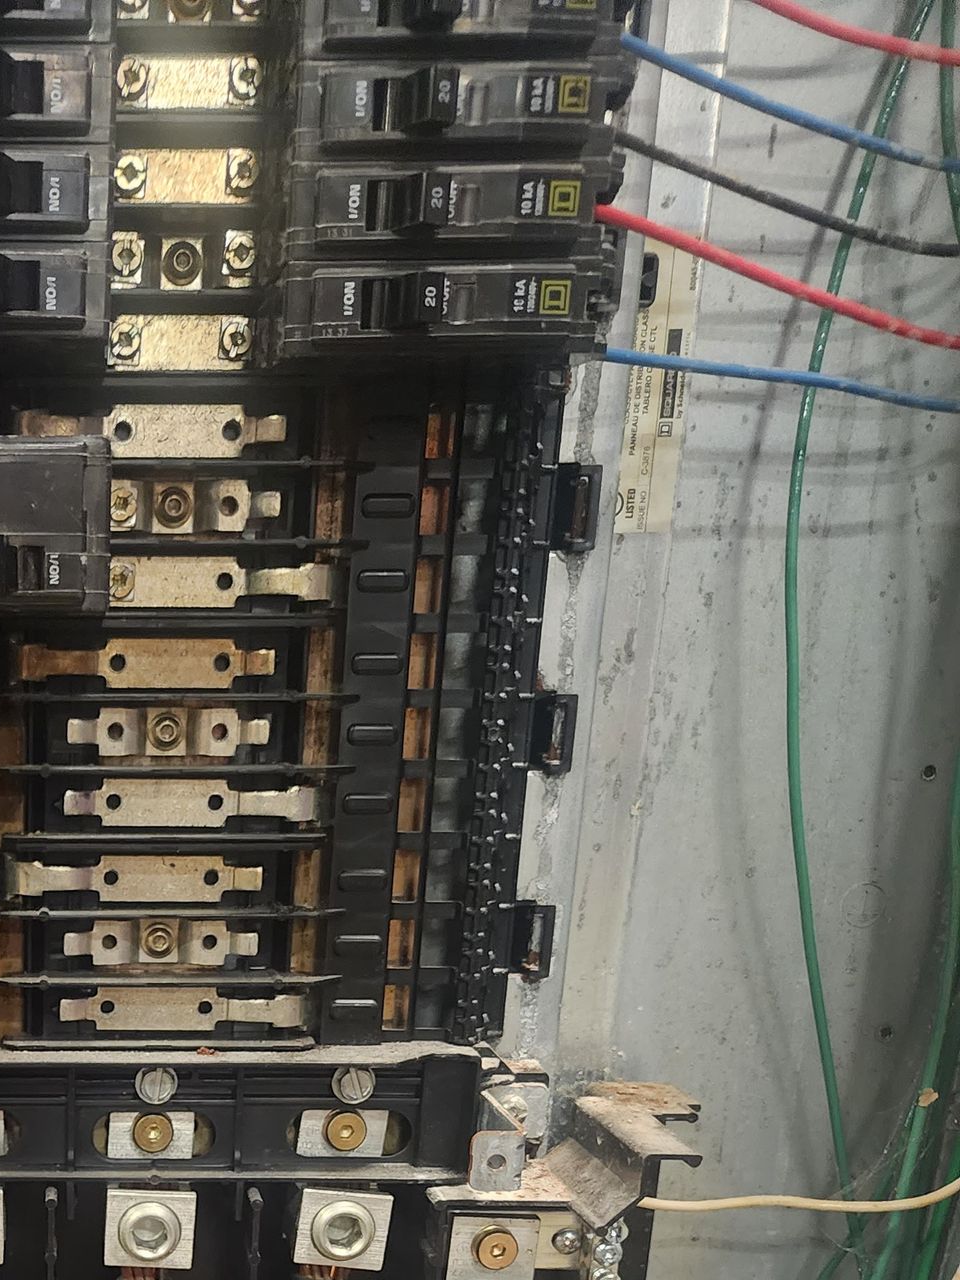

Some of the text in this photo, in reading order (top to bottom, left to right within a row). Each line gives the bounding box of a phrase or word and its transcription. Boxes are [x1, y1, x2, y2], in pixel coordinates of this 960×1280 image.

[50, 78, 62, 114] I/ON
[355, 80, 368, 117] I/ON
[438, 80, 452, 103] 20
[49, 177, 61, 212] I/ON
[348, 184, 361, 219] I/ON
[430, 187, 443, 209] 20
[520, 181, 535, 215] 10 kA
[45, 276, 57, 311] I/ON
[343, 281, 356, 316] I/ON
[425, 286, 437, 307] 20
[515, 279, 527, 296] kA
[642, 373, 652, 415] TABLERO
[649, 325, 658, 341] CTL
[633, 402, 641, 414] DE
[628, 416, 639, 456] PANNEAU
[625, 488, 637, 519] LISTED
[637, 490, 648, 530] ISSUE NO
[48, 554, 60, 585] I/ON
